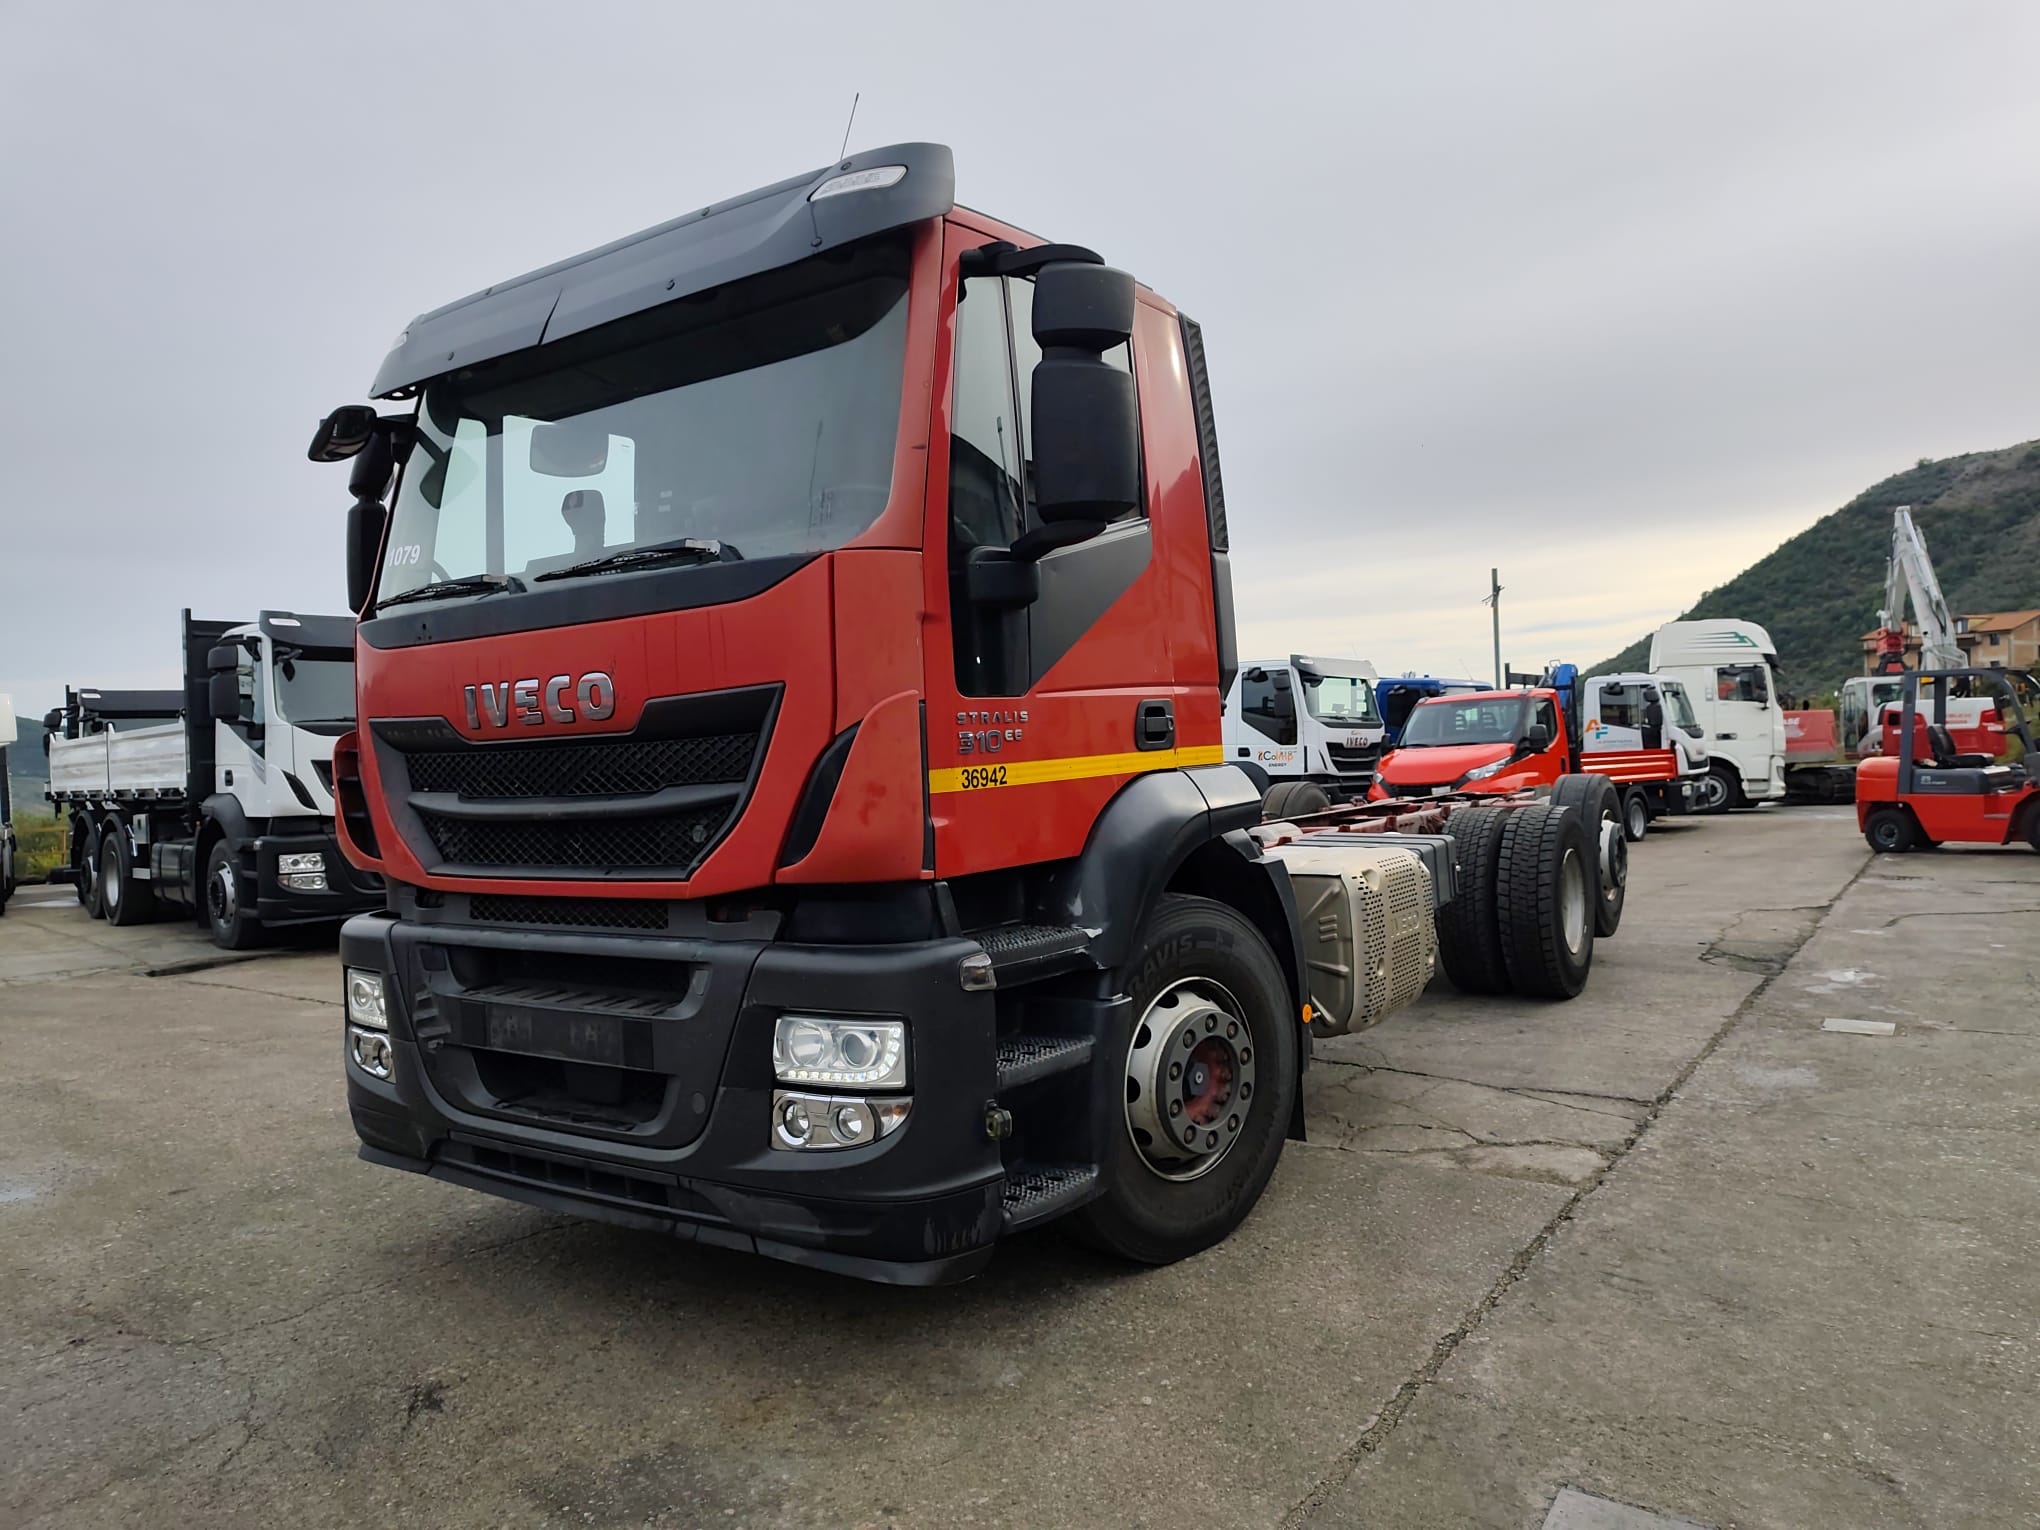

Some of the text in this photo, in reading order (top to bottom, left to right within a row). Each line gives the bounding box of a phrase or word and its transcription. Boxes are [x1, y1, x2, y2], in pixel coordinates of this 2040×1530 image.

[388, 544, 421, 567] 1079
[464, 671, 616, 729] IVECO
[957, 710, 1029, 725] STRALIS
[959, 729, 1003, 754] 310
[1346, 736, 1368, 747] IVECO
[961, 765, 1008, 789] 36942
